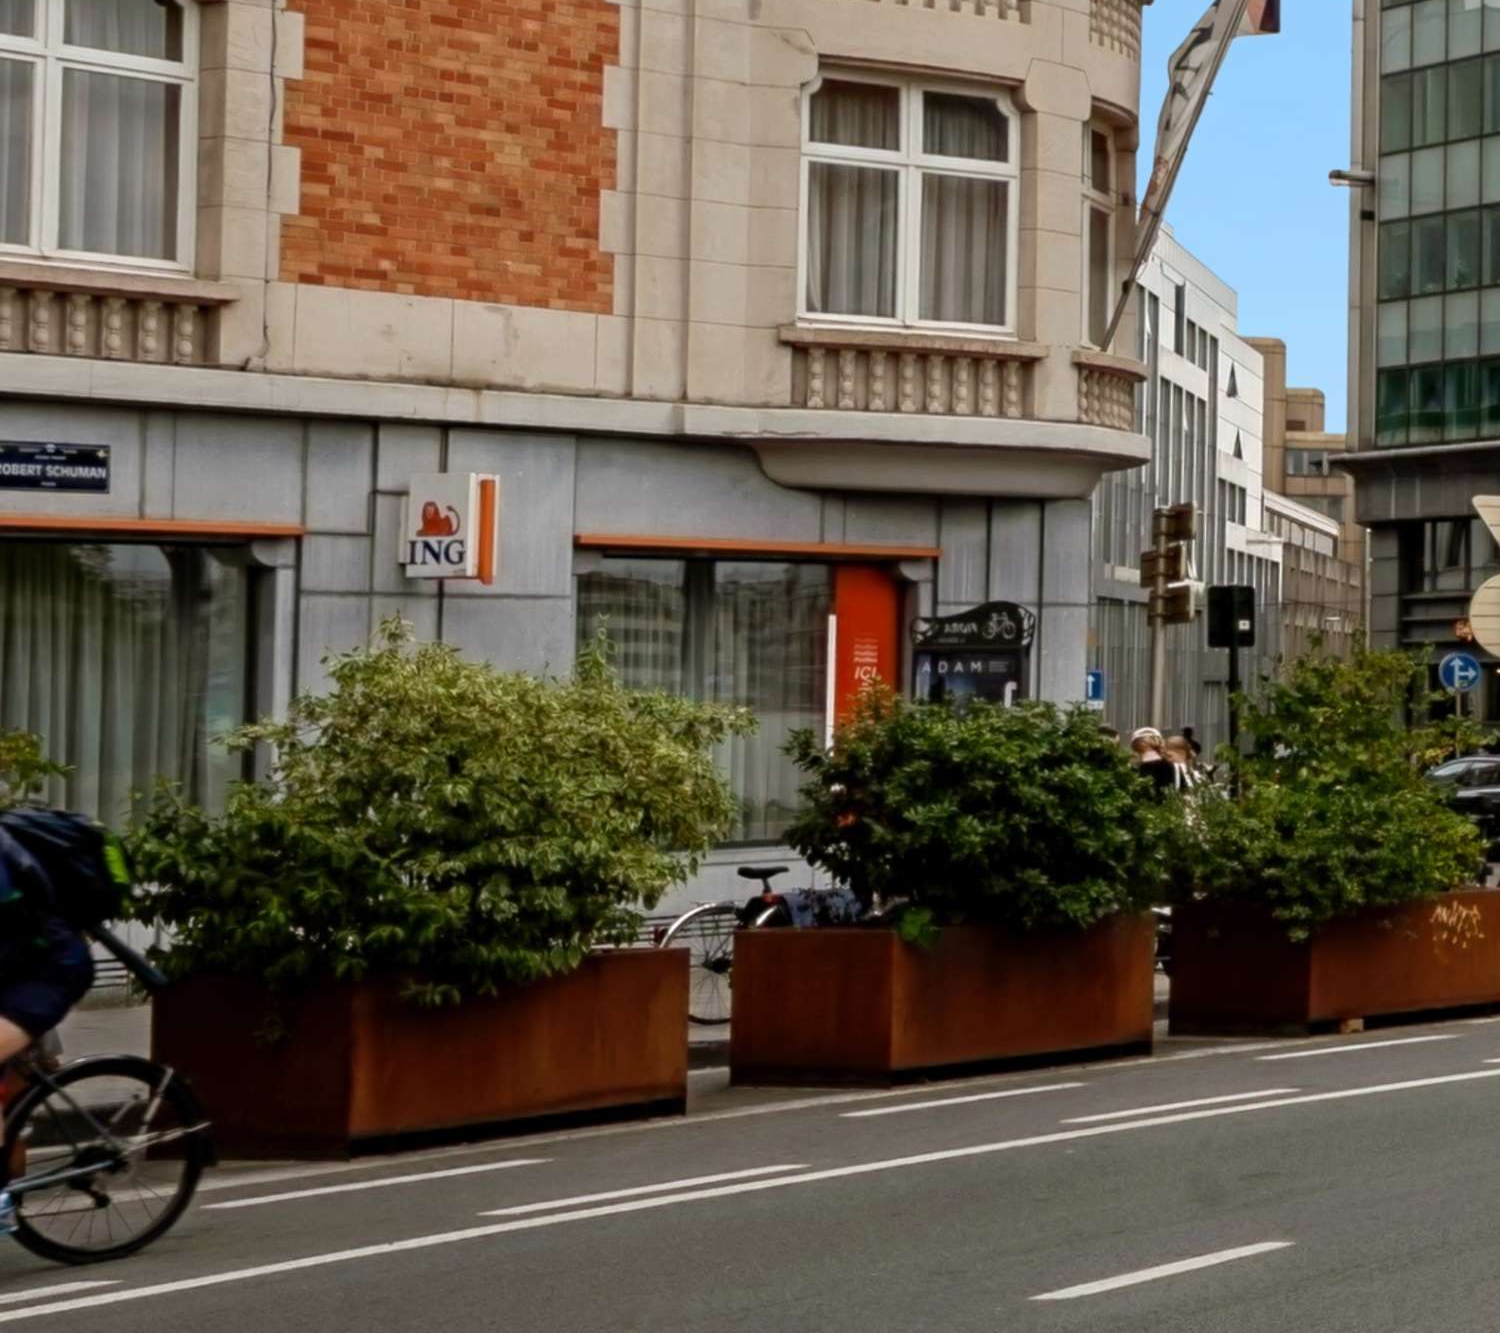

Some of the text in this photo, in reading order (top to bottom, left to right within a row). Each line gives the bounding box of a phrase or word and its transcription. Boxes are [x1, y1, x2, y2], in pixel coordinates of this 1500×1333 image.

[0, 462, 106, 479] OBERT SCHUMAN
[408, 539, 467, 566] ING
